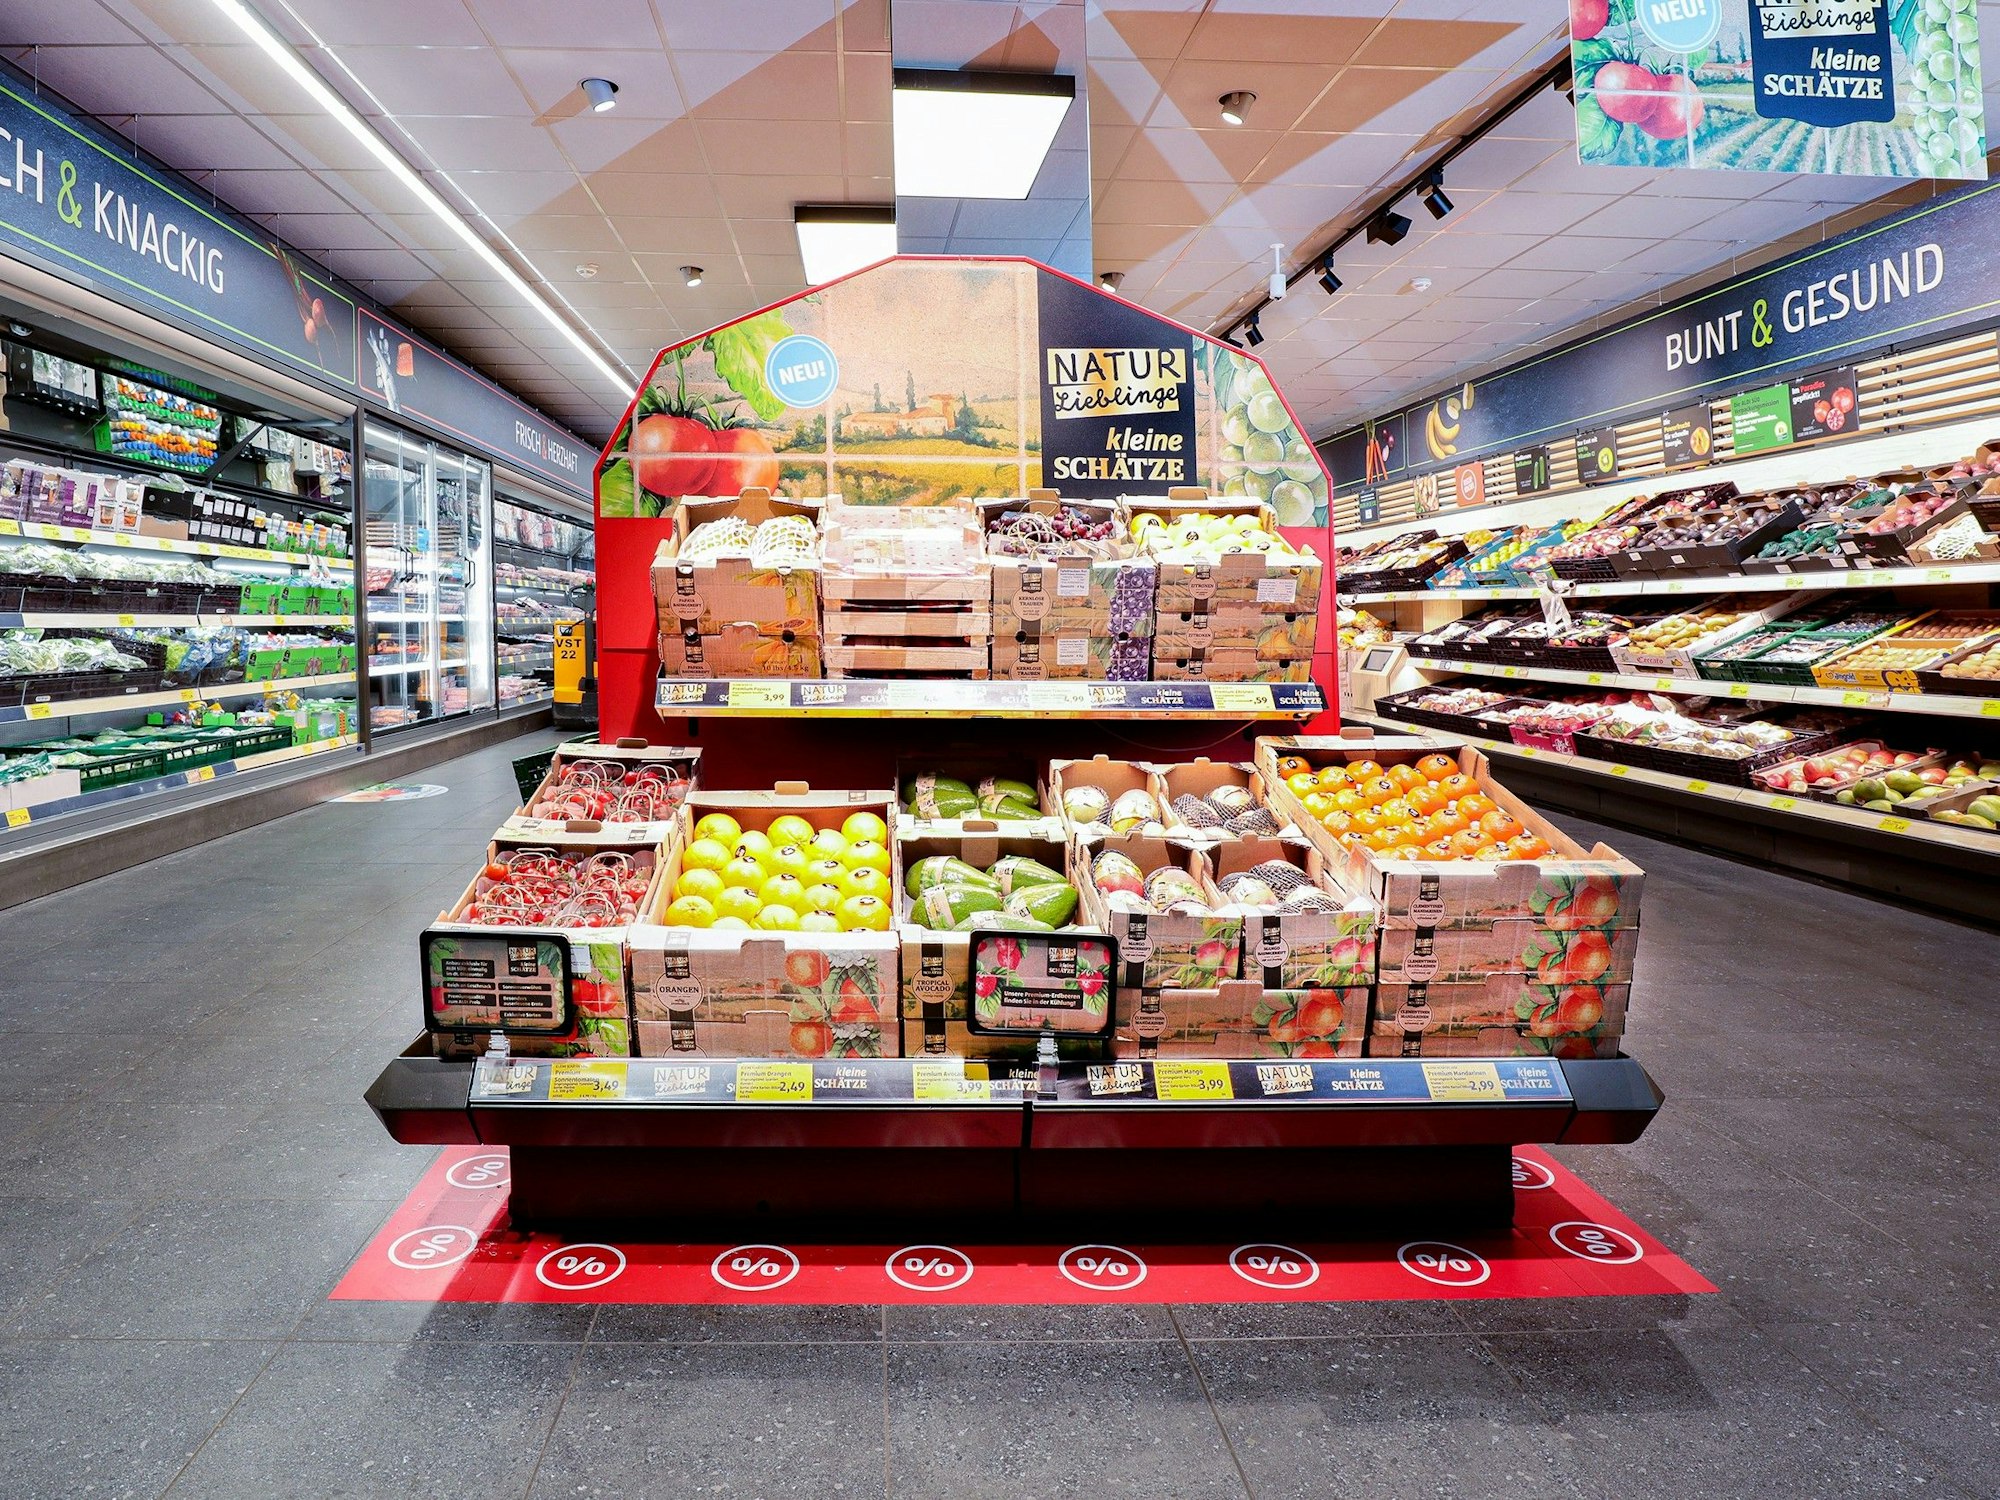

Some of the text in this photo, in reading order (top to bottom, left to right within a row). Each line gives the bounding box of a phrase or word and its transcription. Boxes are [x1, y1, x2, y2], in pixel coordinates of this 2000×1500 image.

[1651, 0, 1707, 24] NEU!
[1763, 9, 1874, 31] Lieblinge
[1810, 47, 1881, 72] kleine
[1763, 71, 1883, 100] SCHÄTZE
[57, 160, 82, 228] &
[94, 182, 224, 293] KNACKIG
[1666, 243, 1944, 371] BUNT & GESUND
[1054, 349, 1181, 384] NATUR
[778, 360, 826, 385] NEU!
[1055, 386, 1178, 411] Lieblinge
[1106, 426, 1183, 451] kleine
[515, 420, 578, 473] FRISCH & HERZHAFT
[1053, 452, 1185, 481] SCHÄTZE
[556, 639, 582, 647] VST
[561, 650, 576, 659] 22
[662, 683, 704, 694] NATUR
[803, 684, 844, 695] NATUR
[1156, 689, 1182, 697] kleine
[1295, 689, 1319, 697] kleine
[765, 693, 784, 702] 3,99
[1140, 696, 1184, 704] SCHÄTZE
[1280, 696, 1322, 704] SCHÄTZE
[1025, 991, 1081, 999] Premium-Erdbeeren
[1050, 999, 1076, 1007] Kühlung!
[656, 1068, 707, 1081] NATUR
[836, 1067, 866, 1077] kleine
[1090, 1065, 1140, 1079] NATUR
[1260, 1066, 1311, 1079] NATUR
[1350, 1069, 1380, 1078] kleine
[1517, 1067, 1548, 1077] kleine
[593, 1081, 619, 1092] 3,49
[656, 1081, 704, 1093] Lieblinge
[780, 1082, 805, 1093] 2,49
[814, 1077, 867, 1088] SCHÄTZE
[957, 1082, 982, 1093] 3,99
[1091, 1080, 1140, 1092] Lieblinge
[1199, 1080, 1223, 1090] 3,99
[1264, 1079, 1311, 1091] Lieblinge
[1331, 1078, 1384, 1090] SCHÄTZE
[1470, 1081, 1494, 1092] 2,99
[1501, 1077, 1552, 1089] SCHÄTZE
